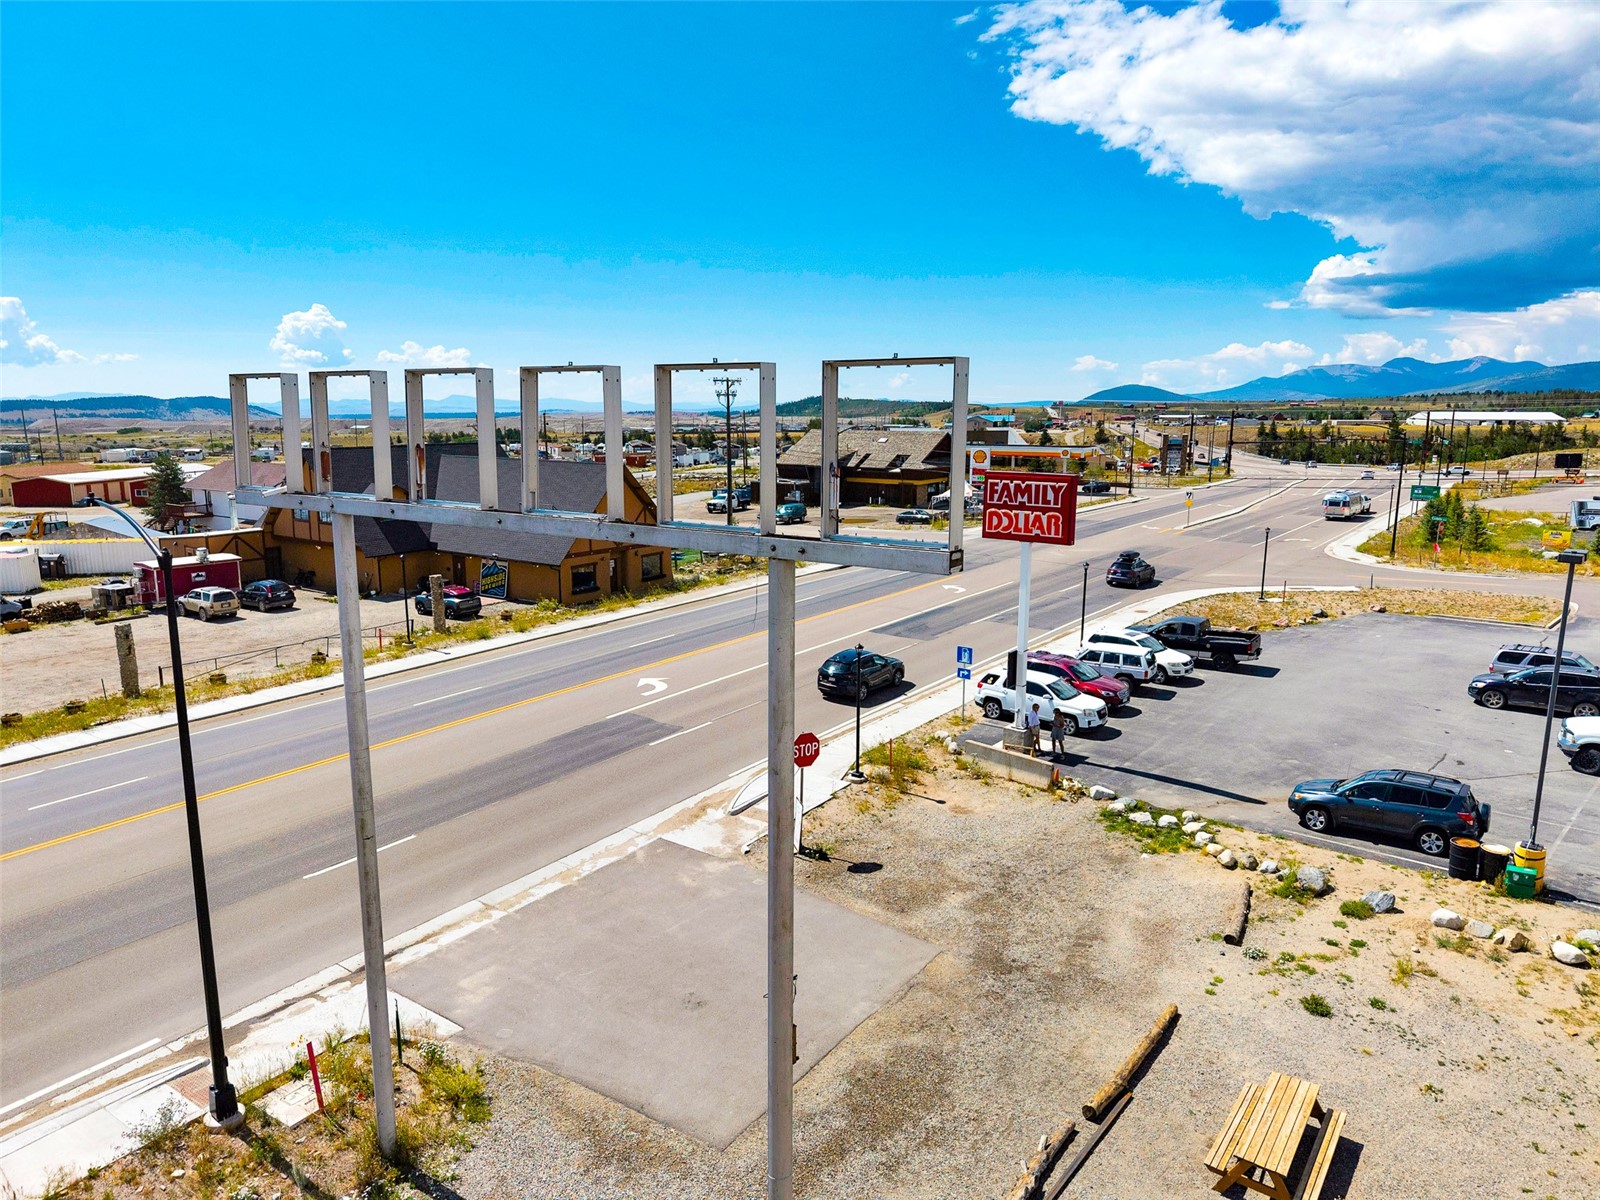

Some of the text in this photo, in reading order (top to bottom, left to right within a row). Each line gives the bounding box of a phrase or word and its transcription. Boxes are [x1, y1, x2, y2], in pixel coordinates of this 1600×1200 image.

[987, 479, 1068, 508] FAMILY
[985, 508, 1063, 539] DOLLAR
[794, 742, 819, 758] STOP
